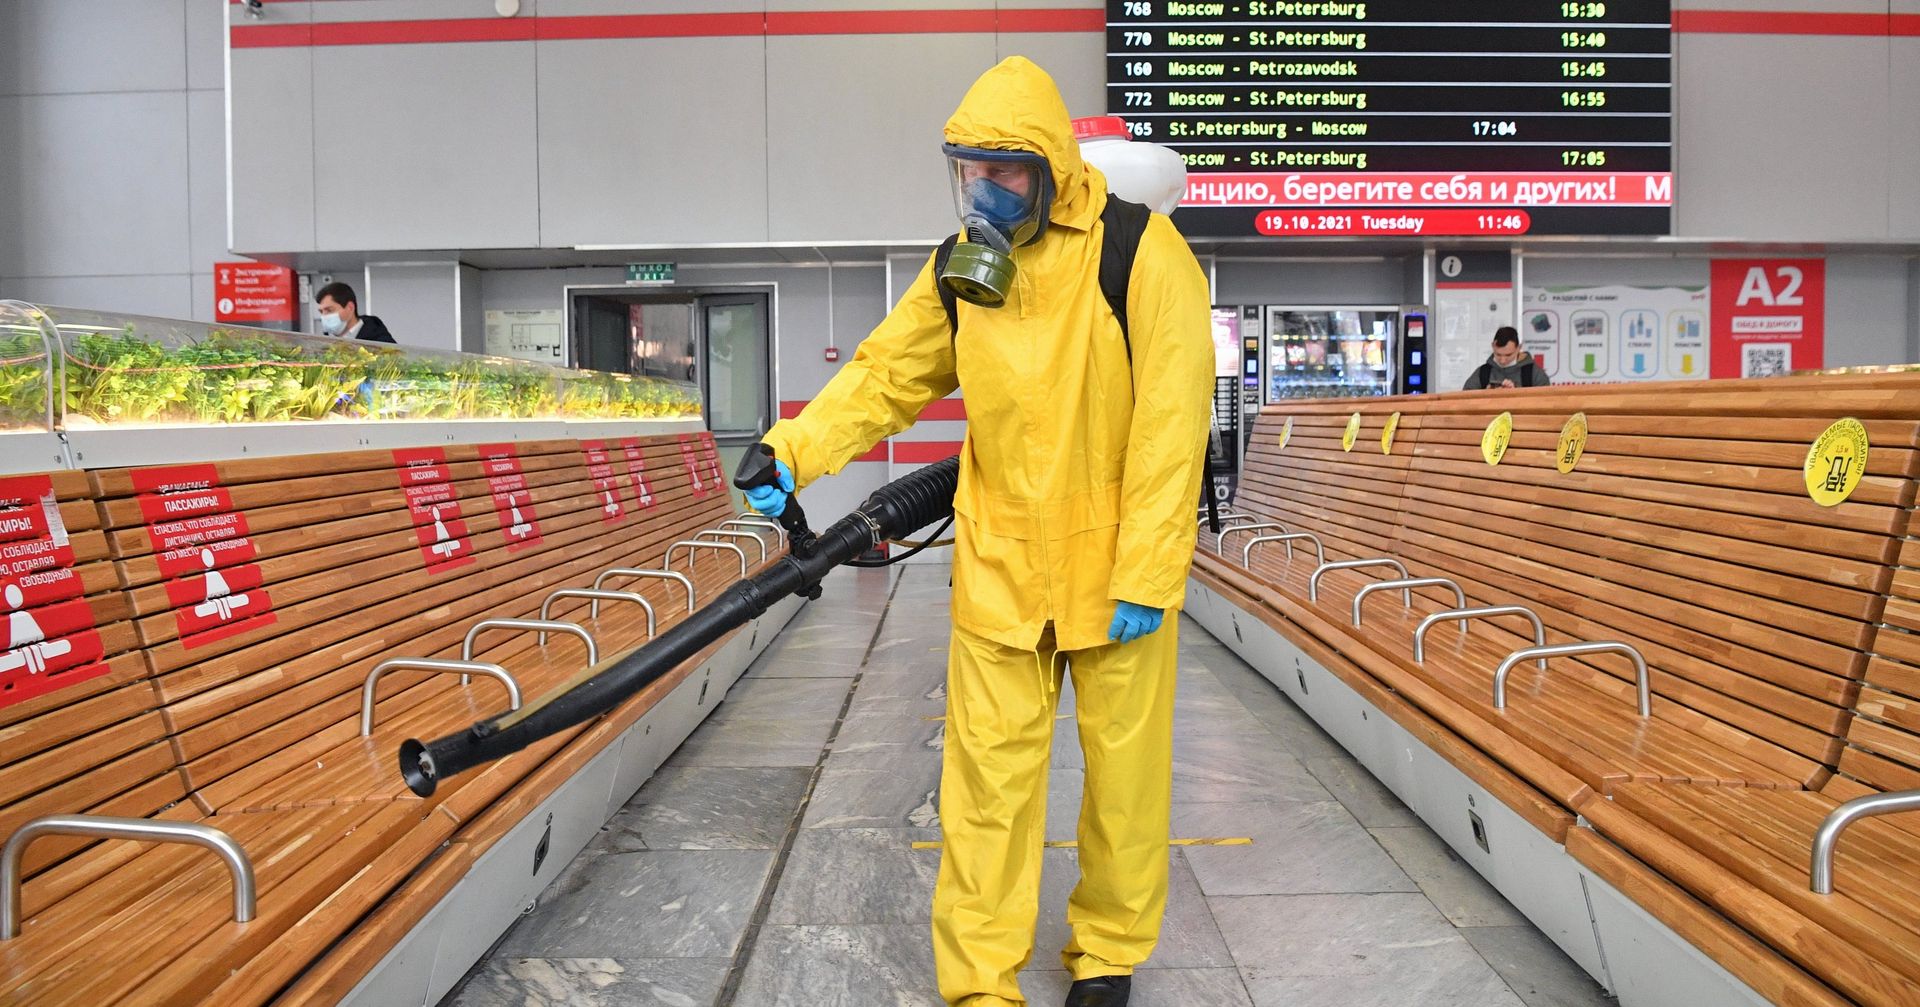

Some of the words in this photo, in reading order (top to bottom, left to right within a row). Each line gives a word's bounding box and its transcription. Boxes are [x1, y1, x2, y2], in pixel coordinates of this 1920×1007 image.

[1123, 1, 1152, 17] 768
[1167, 1, 1225, 16] Moscow
[1249, 1, 1366, 20] St.Petersburg
[1561, 2, 1606, 18] 15:30
[1123, 31, 1152, 47] 770
[1167, 31, 1225, 46] Moscow
[1249, 30, 1366, 49] St.Petersburg
[1561, 32, 1606, 48] 15:40
[1124, 61, 1153, 77] 160
[1168, 61, 1225, 76] Moscow
[1249, 60, 1358, 76] Petrozavodsk
[1561, 61, 1606, 77] 15:45
[1124, 91, 1153, 107] 772
[1168, 91, 1225, 106] Moscow
[1249, 90, 1367, 109] St.Petersburg
[1561, 91, 1606, 107] 16:55
[1126, 121, 1153, 137] 765
[1169, 120, 1287, 139] St.Petersburg
[1311, 121, 1368, 136] Moscow
[1472, 121, 1517, 136] 17:04
[1182, 152, 1225, 166] oscow
[1250, 151, 1367, 169] St.Petersburg
[1561, 150, 1606, 166] 17:05
[1187, 182, 1276, 204] нцию,
[1284, 176, 1413, 204] берегите
[1420, 176, 1482, 200] себя
[1491, 182, 1507, 200] и
[1513, 176, 1616, 204] других!
[1265, 215, 1352, 230] 19.10.2021
[1361, 215, 1424, 233] Tuesday
[1478, 215, 1522, 230] 11:46
[164, 495, 219, 513] ПАССАЖИРЫ!
[153, 523, 187, 536] СПАСИБО,
[186, 520, 199, 530] ЧТО
[199, 514, 238, 528] СОБЛЮДАЕТЕ
[206, 527, 236, 540] ОСТАВЛЯЯ
[19, 567, 74, 588] СВОБОДНЫМ
